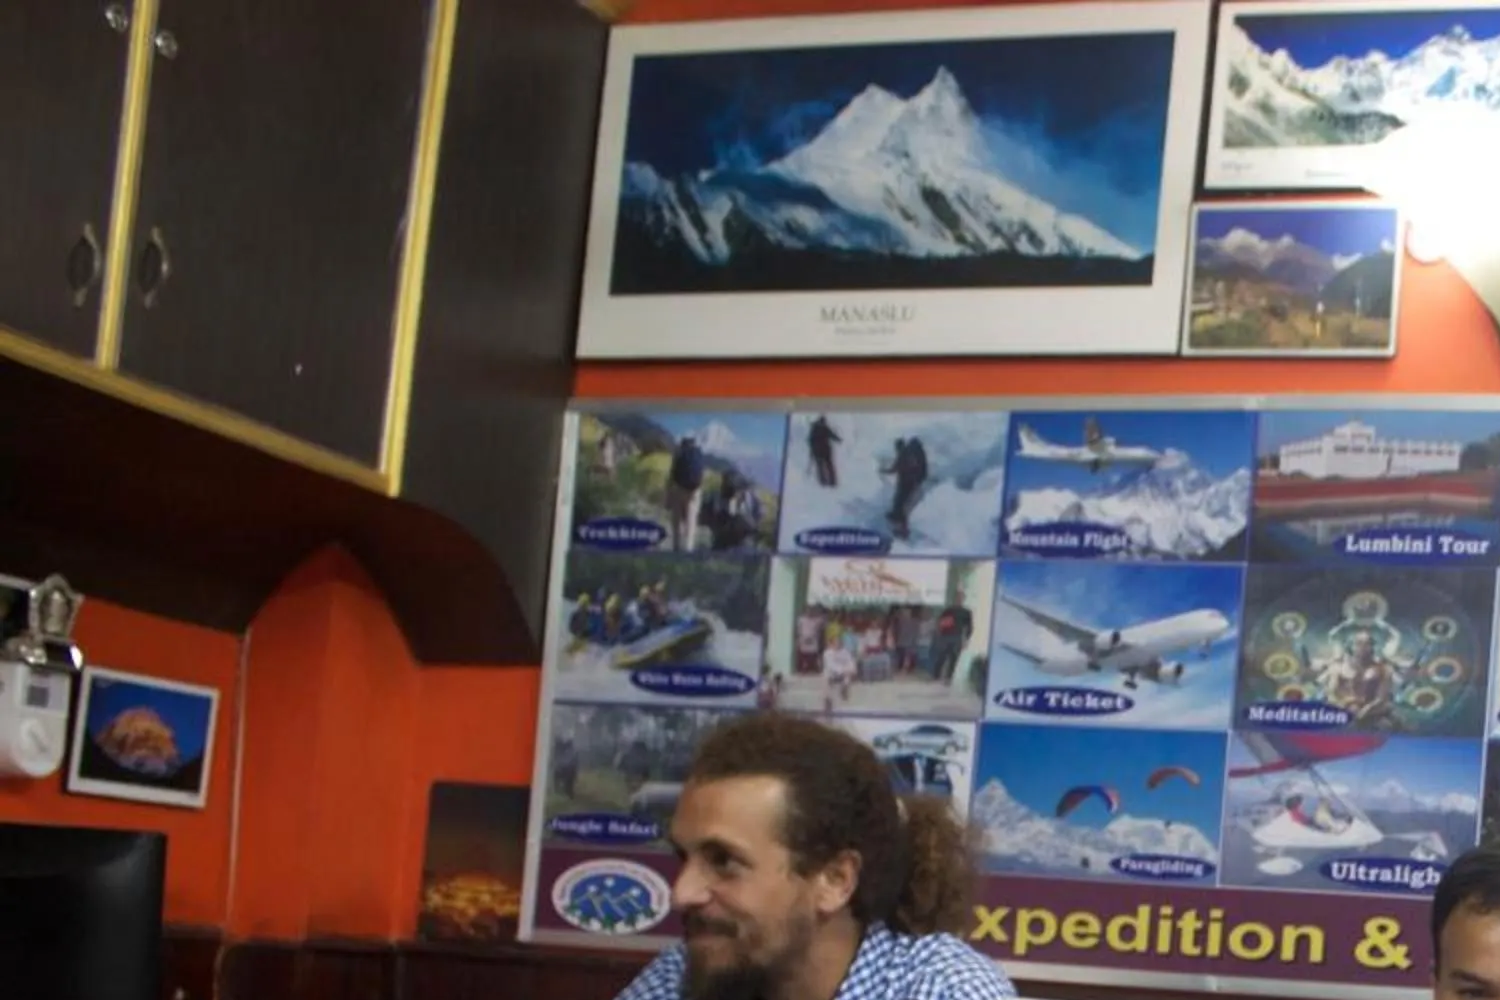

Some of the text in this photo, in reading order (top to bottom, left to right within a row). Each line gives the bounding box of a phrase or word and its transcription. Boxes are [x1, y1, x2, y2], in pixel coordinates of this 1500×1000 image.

[820, 305, 916, 322] MANASLU
[578, 524, 660, 543] Trekking
[1008, 530, 1129, 551] Mountain Flight
[1345, 533, 1490, 556] Lumbini Tour
[1001, 690, 1126, 710] Air Ticket
[1249, 705, 1349, 725] Meditation
[1331, 861, 1442, 889] Ultraligh
[970, 903, 1326, 964] xpedition
[1354, 915, 1413, 970] &
